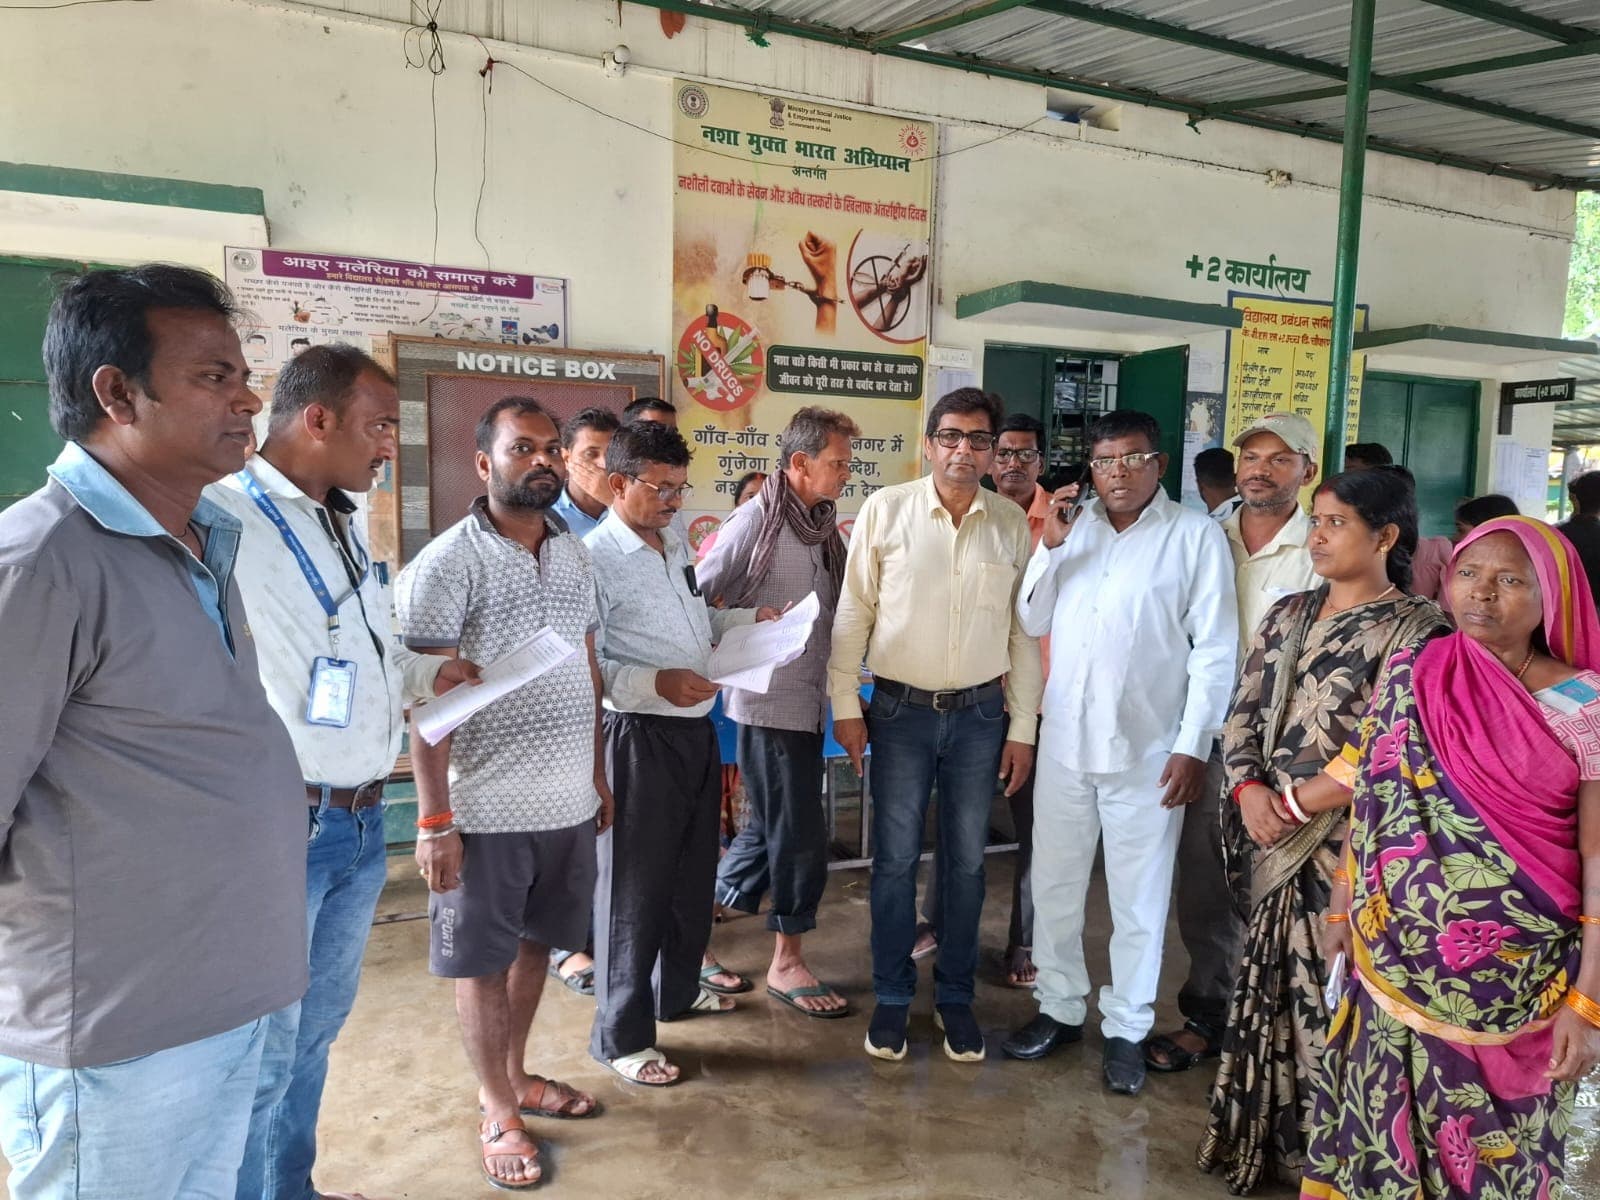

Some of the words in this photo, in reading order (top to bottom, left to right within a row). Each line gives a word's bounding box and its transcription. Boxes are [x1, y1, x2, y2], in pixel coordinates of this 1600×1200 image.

[788, 104, 808, 114] Ministry
[817, 109, 832, 117] Social
[834, 112, 852, 121] Justice
[793, 113, 830, 124] Empowerment
[701, 124, 740, 147] नशा
[746, 132, 788, 156] मुक्त
[795, 140, 837, 161] भारत
[844, 147, 911, 173] अभियान
[792, 165, 828, 181] अन्तर्गत
[678, 173, 709, 193] नशीली
[736, 179, 746, 197] के
[747, 181, 768, 200] सेवन
[770, 184, 785, 203] और
[787, 187, 805, 206] अवैध
[807, 192, 832, 209] तस्करी
[834, 193, 842, 209] के
[843, 194, 872, 214] खिलाफ
[908, 203, 927, 221] दिवस
[282, 256, 330, 271] आइए
[336, 260, 400, 277] मलेरिया
[405, 267, 428, 279] को
[433, 270, 485, 285] समाप्त
[491, 275, 518, 288] करें
[1224, 254, 1311, 298] कार्यालय
[1280, 313, 1310, 329] प्रबंधन
[1311, 316, 1332, 330] समि
[457, 351, 557, 377] NOTICE
[564, 360, 616, 380] BOX
[693, 330, 711, 352] NO
[708, 351, 743, 397] DRUGS
[792, 353, 806, 368] चाहे
[808, 355, 827, 369] किसी
[829, 356, 838, 370] भी
[841, 360, 859, 371] प्रकार
[862, 362, 872, 372] का
[874, 360, 882, 373] हो
[897, 362, 918, 375] आपके
[778, 372, 800, 386] जीवन
[803, 374, 813, 387] को
[816, 374, 828, 391] पूरी
[830, 377, 844, 389] तरह
[846, 377, 853, 389] से
[876, 381, 886, 392] कर
[889, 381, 901, 392] देता
[693, 424, 770, 448] गाँव-गाँव
[891, 434, 904, 452] में
[718, 450, 770, 476] गुंजेगा
[848, 457, 880, 477] न्देश,
[441, 907, 455, 958] SPORTS
